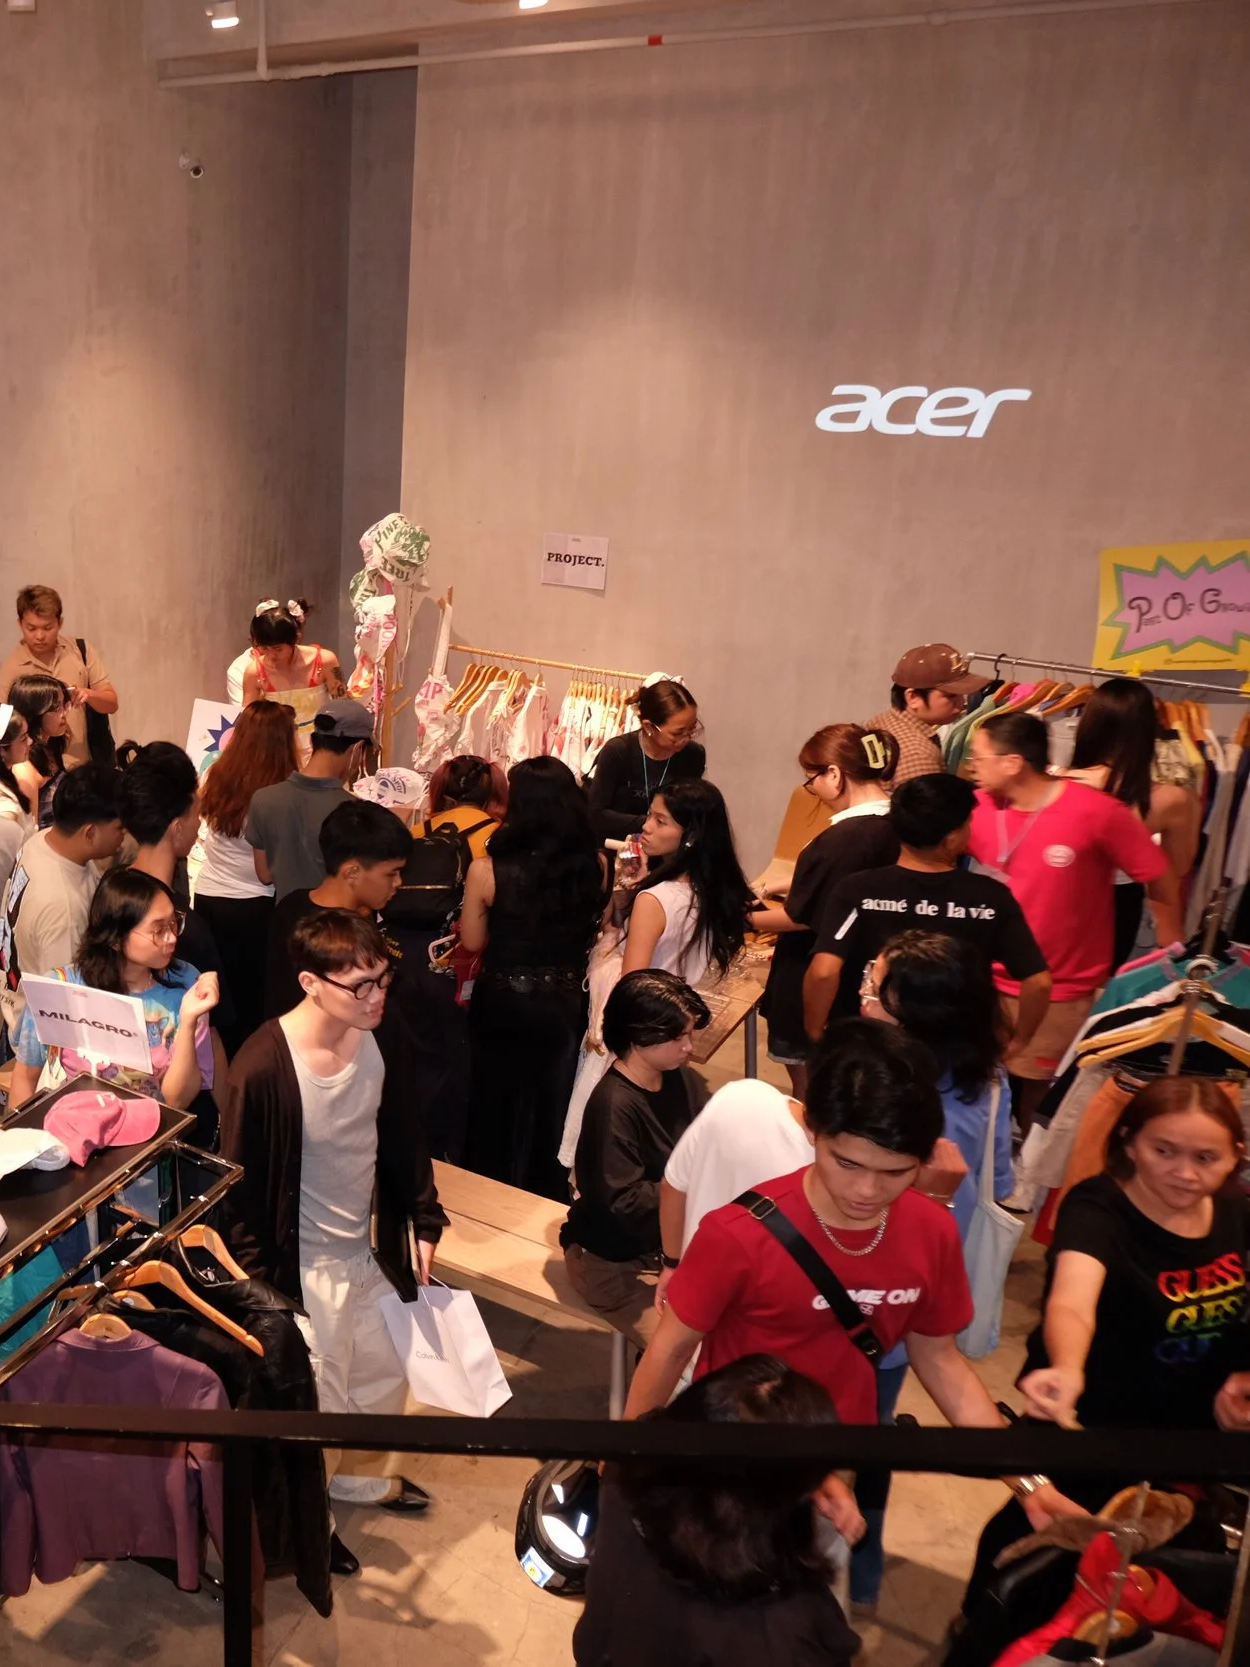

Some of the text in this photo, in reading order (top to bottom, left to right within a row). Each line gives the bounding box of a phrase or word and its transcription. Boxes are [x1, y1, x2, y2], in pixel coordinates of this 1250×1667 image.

[815, 384, 1032, 438] acer
[546, 552, 605, 567] PROJECT.
[915, 899, 938, 916] de
[946, 902, 966, 919] la
[968, 904, 996, 920] vie
[811, 1288, 887, 1311] GME
[887, 1287, 921, 1305] ON
